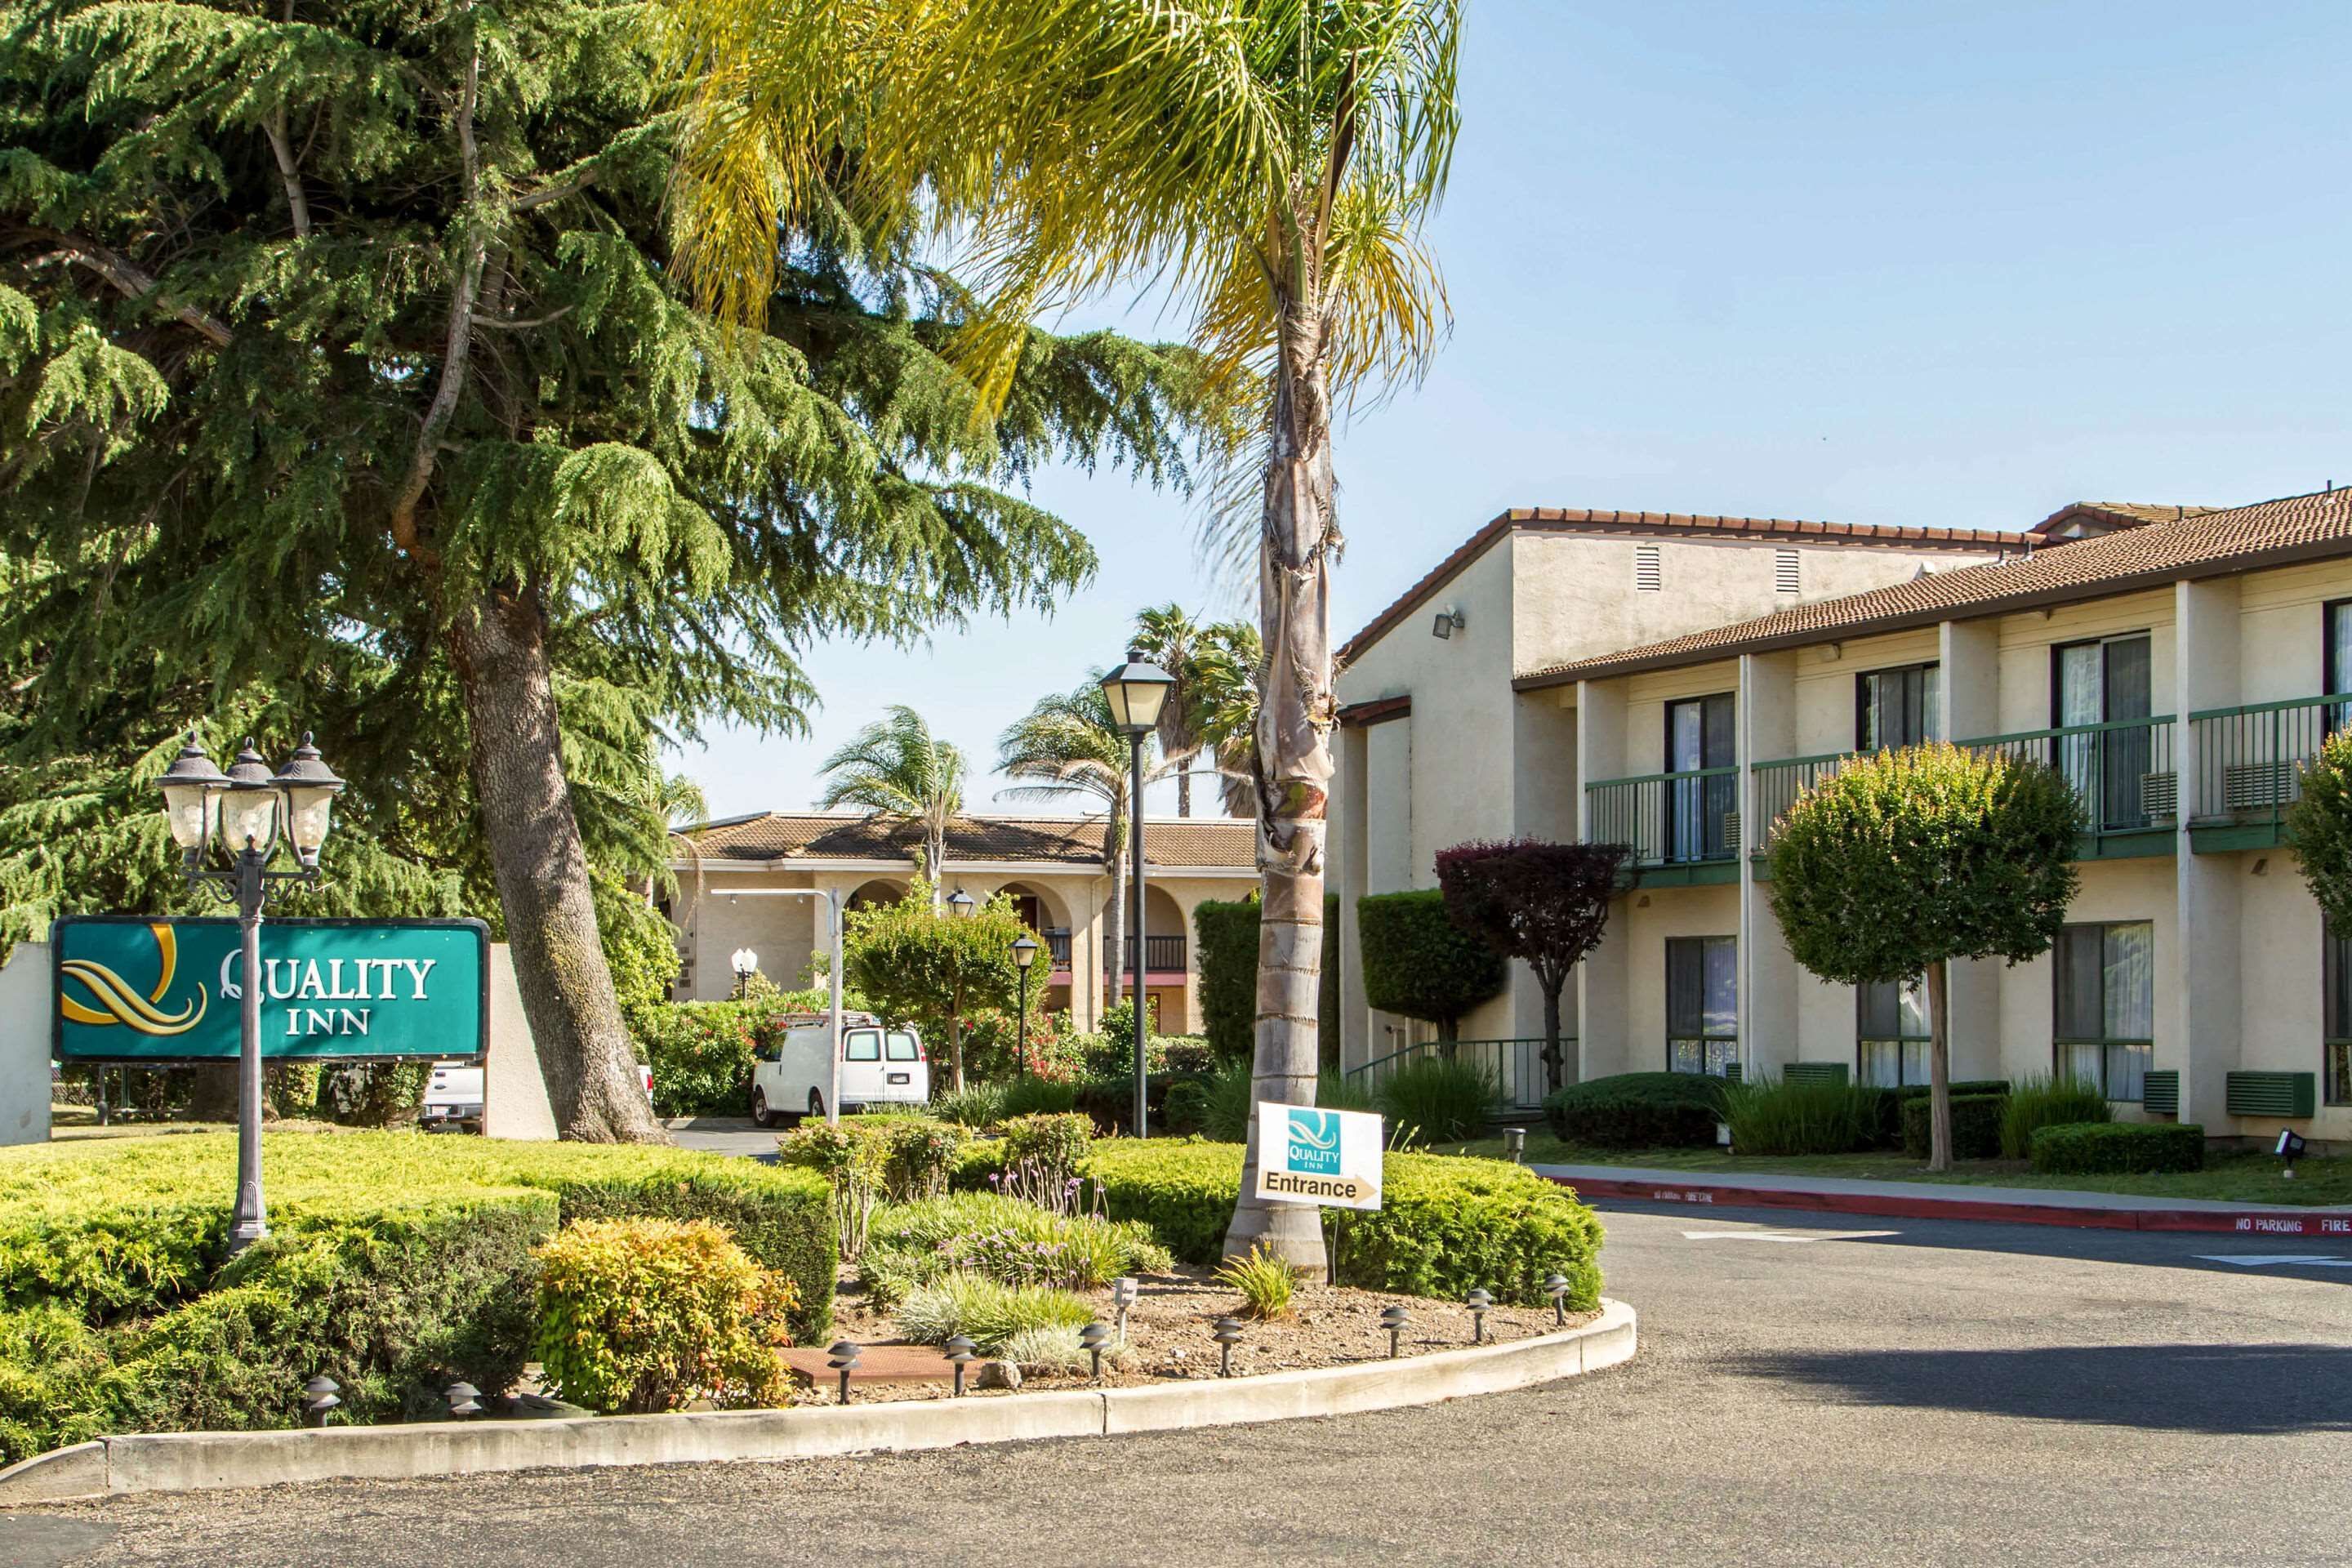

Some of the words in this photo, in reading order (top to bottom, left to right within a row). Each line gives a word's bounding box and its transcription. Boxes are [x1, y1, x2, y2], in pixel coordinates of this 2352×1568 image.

[286, 1008, 370, 1036] INN
[1290, 1145, 1339, 1163] QUALITY
[1304, 1161, 1324, 1169] INN
[1266, 1172, 1357, 1198] Entrance
[2235, 1218, 2252, 1231] NO
[2256, 1218, 2303, 1232] PARKING
[2321, 1219, 2351, 1232] FIRE
